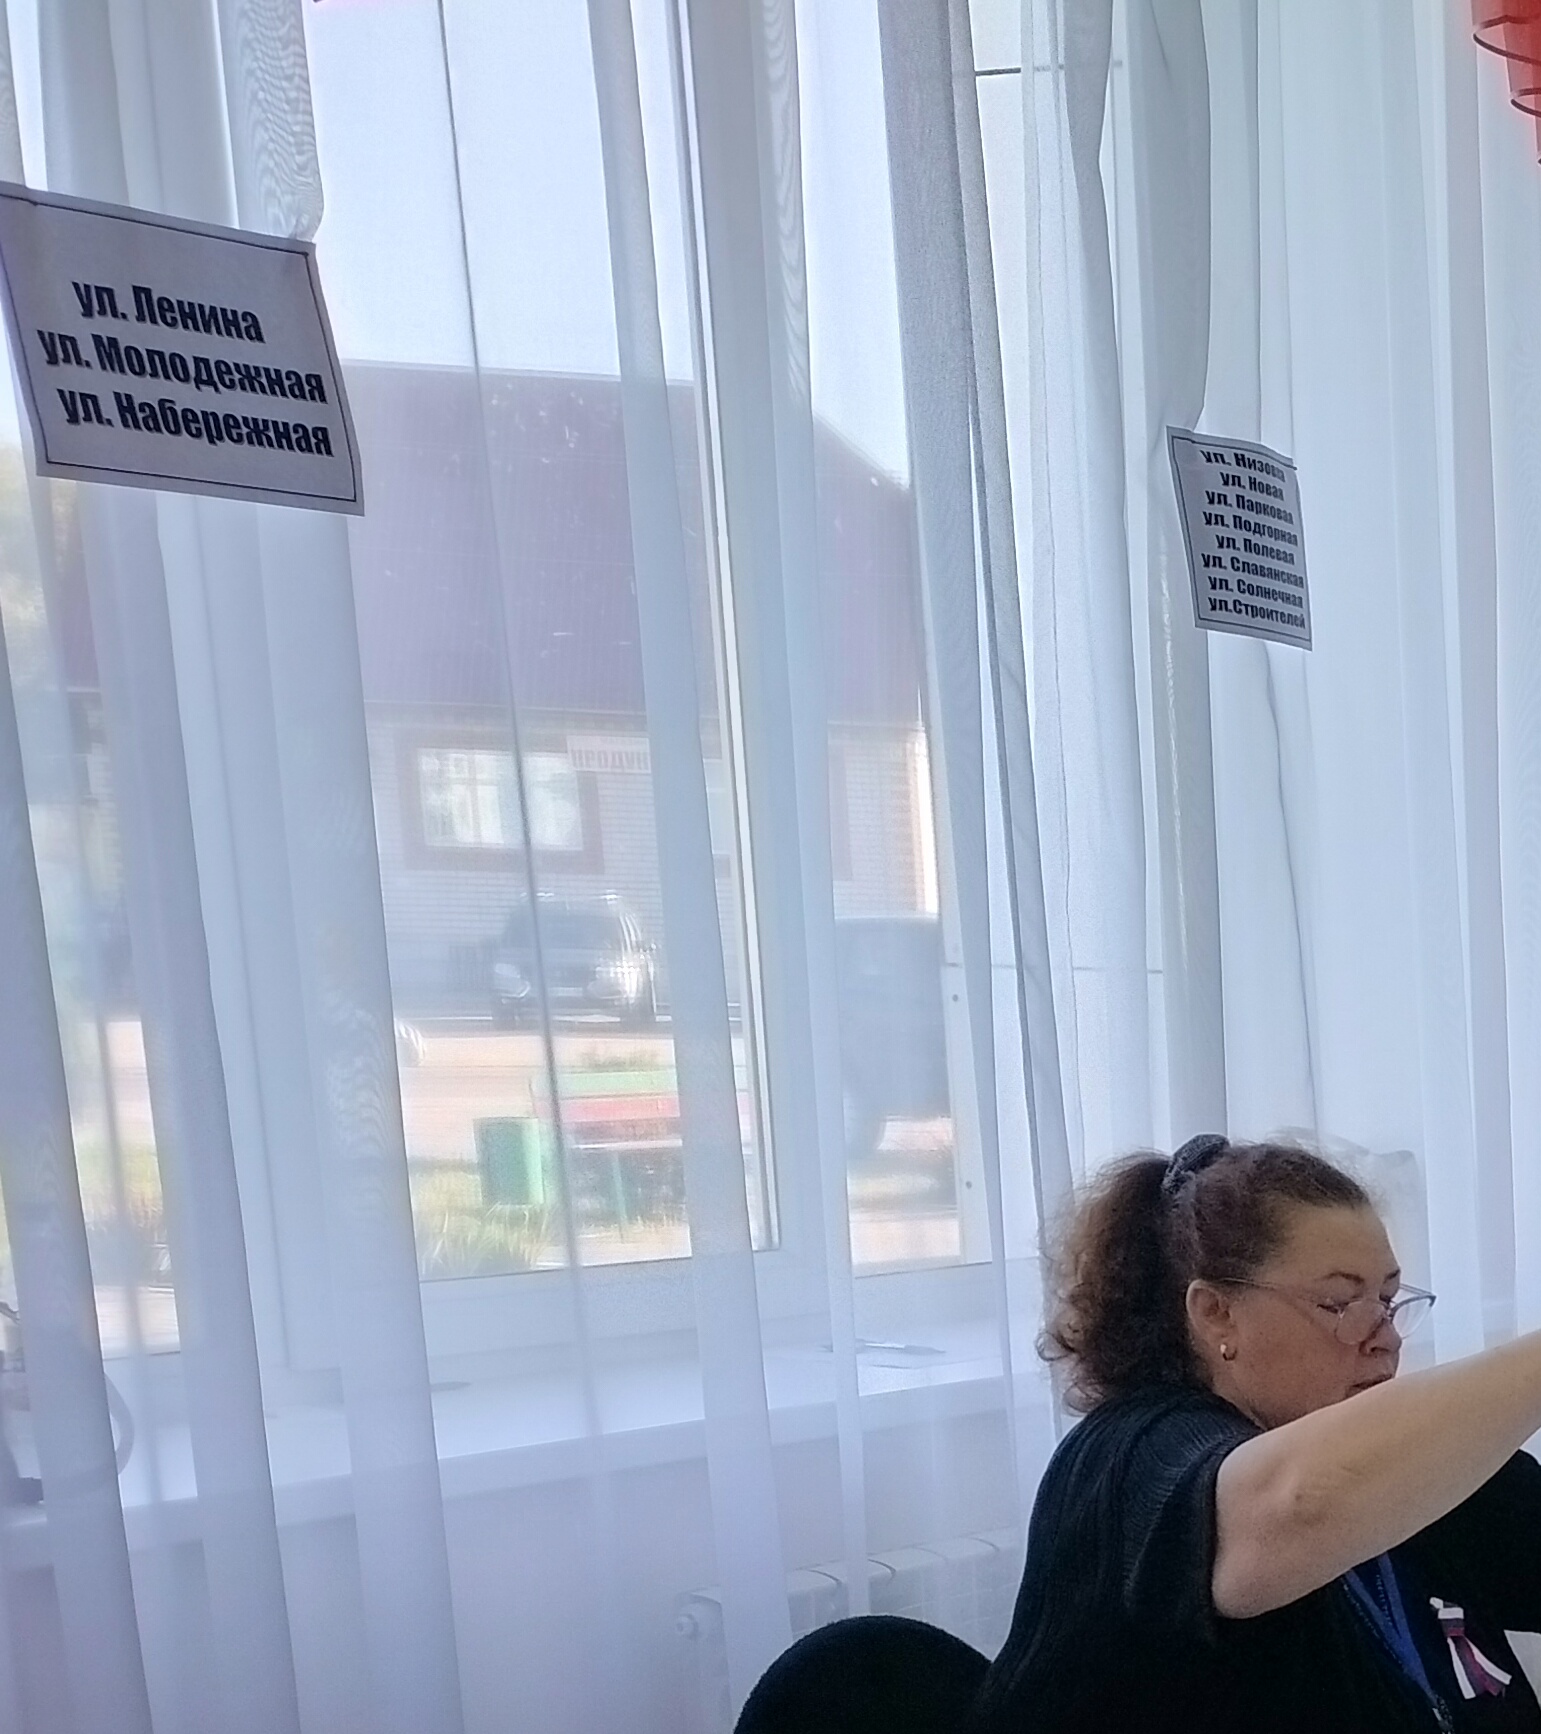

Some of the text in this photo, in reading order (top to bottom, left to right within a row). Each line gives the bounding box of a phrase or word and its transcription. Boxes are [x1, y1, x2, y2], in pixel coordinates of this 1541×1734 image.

[72, 282, 265, 343] ул. Ленина
[37, 330, 328, 404] ул. Молодежная
[57, 389, 334, 457] ул. Набережная
[1201, 450, 1231, 466] ул.
[1220, 472, 1284, 501] ул. Новая
[1205, 491, 1294, 525] ул. Парковая
[1203, 511, 1298, 547] ул. Подгорная
[1216, 535, 1295, 565] ул. Полевая
[1201, 554, 1304, 589] ул. Славянская
[1208, 576, 1303, 609] ул. Солнечная
